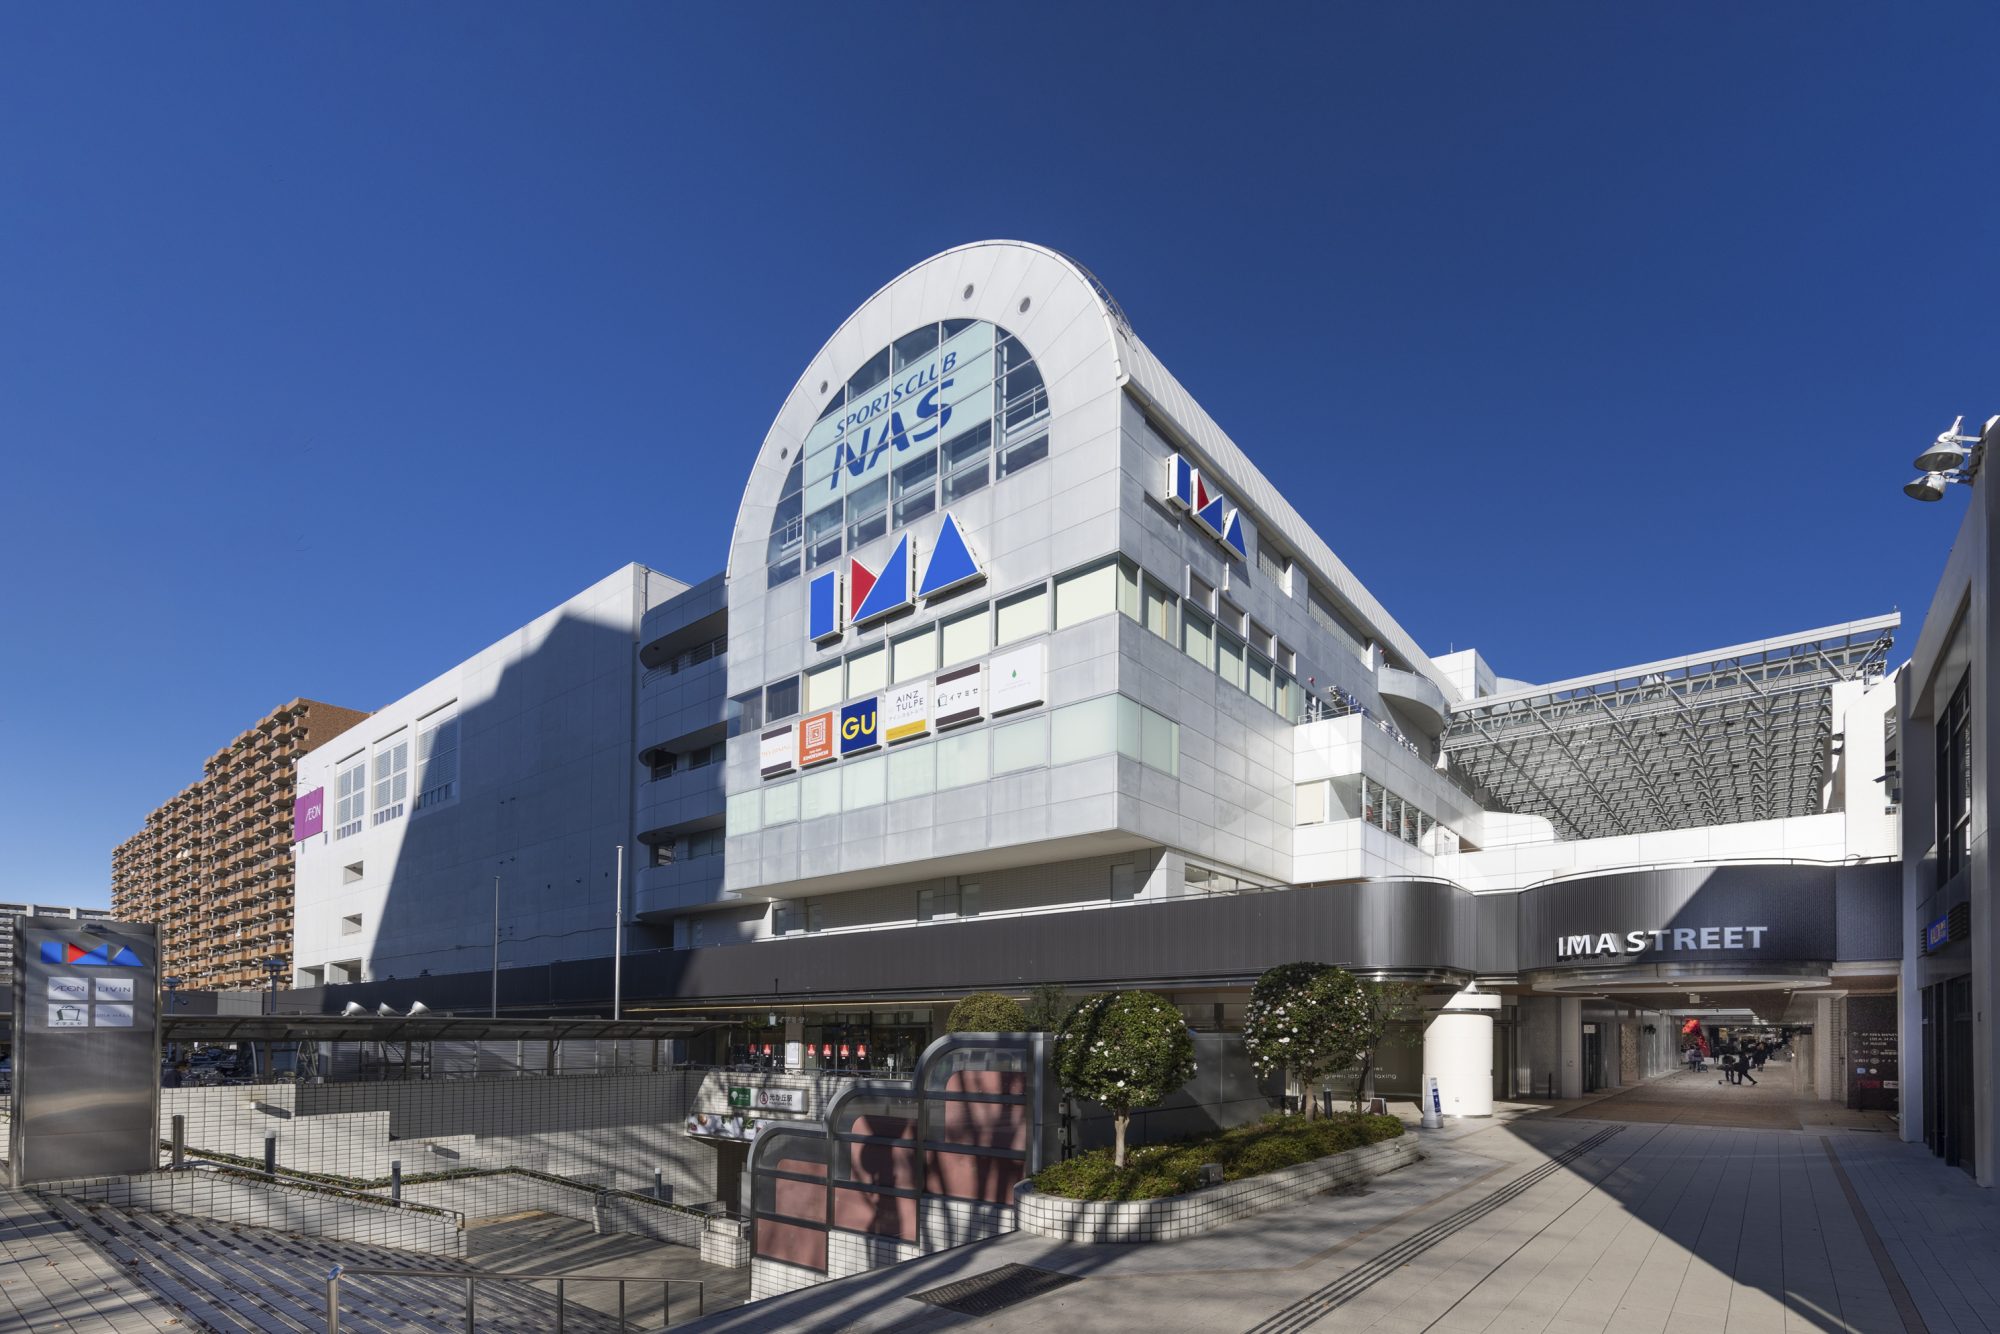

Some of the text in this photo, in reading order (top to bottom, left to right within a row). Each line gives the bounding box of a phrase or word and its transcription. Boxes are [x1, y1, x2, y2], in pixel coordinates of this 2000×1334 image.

[830, 378, 955, 491] NAS
[896, 689, 920, 703] AINZ
[896, 699, 925, 712] TULPE
[842, 711, 876, 740] GU
[1557, 926, 1768, 957] IMA STREET
